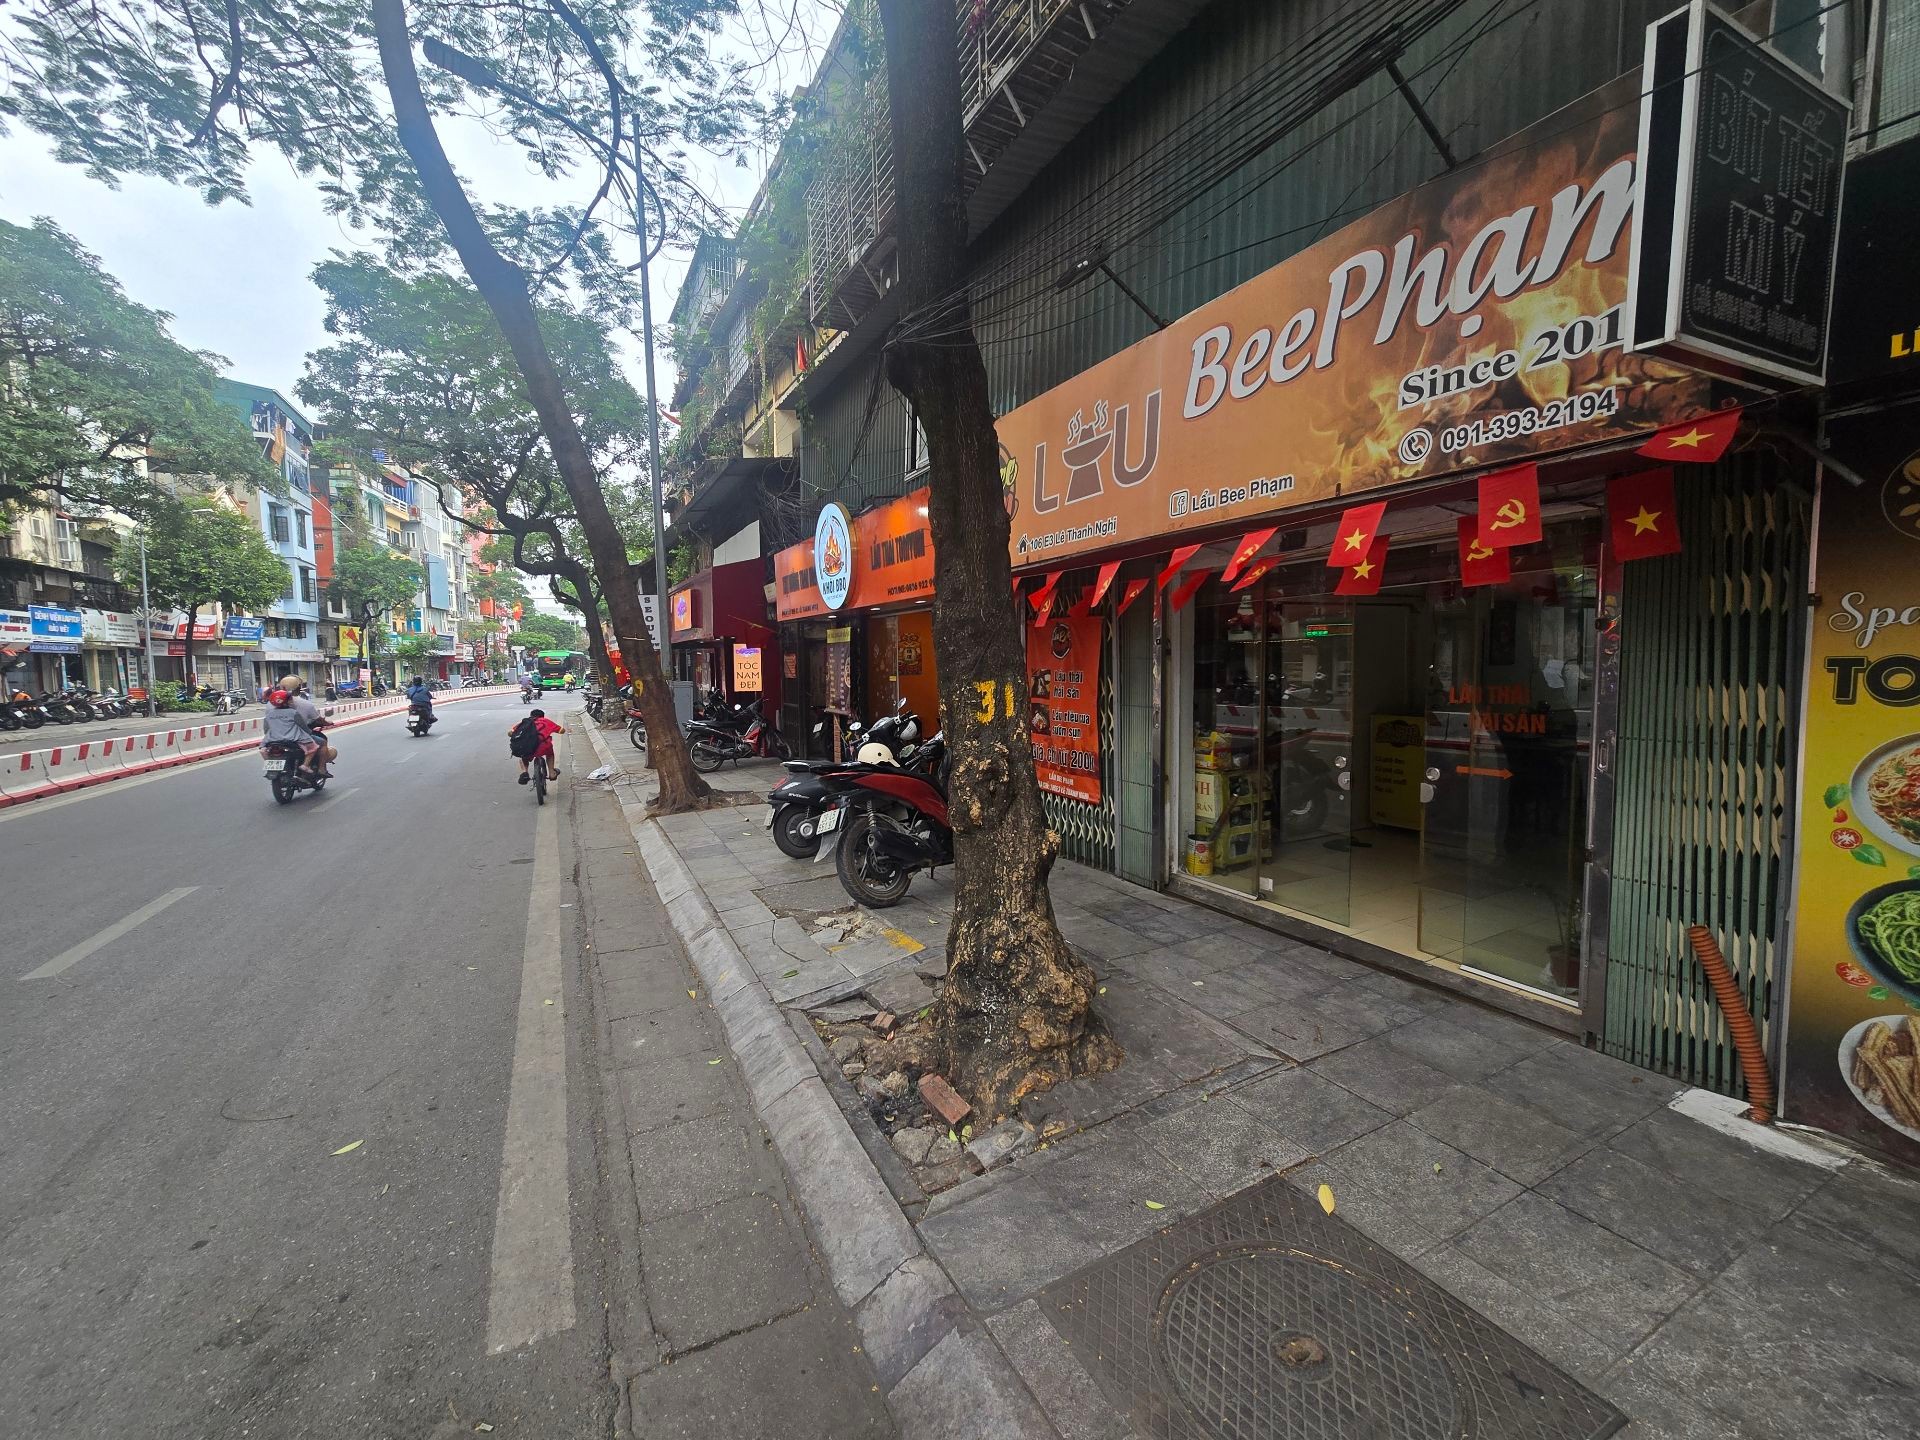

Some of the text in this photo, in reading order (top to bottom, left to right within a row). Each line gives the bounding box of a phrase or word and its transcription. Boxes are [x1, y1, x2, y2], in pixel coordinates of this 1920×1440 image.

[1400, 306, 1624, 408] Since 201
[1441, 389, 1617, 452] 091.393.2194
[1192, 490, 1215, 512] Lẩu
[1219, 487, 1246, 505] Bee
[1250, 474, 1294, 498] Phạm
[1030, 517, 1117, 550] 106 E3 Lê Thanh Nghị
[736, 671, 760, 679] NAM
[738, 660, 759, 670] TÓC
[740, 680, 757, 689] ĐẸP
[973, 680, 1015, 725] 31
